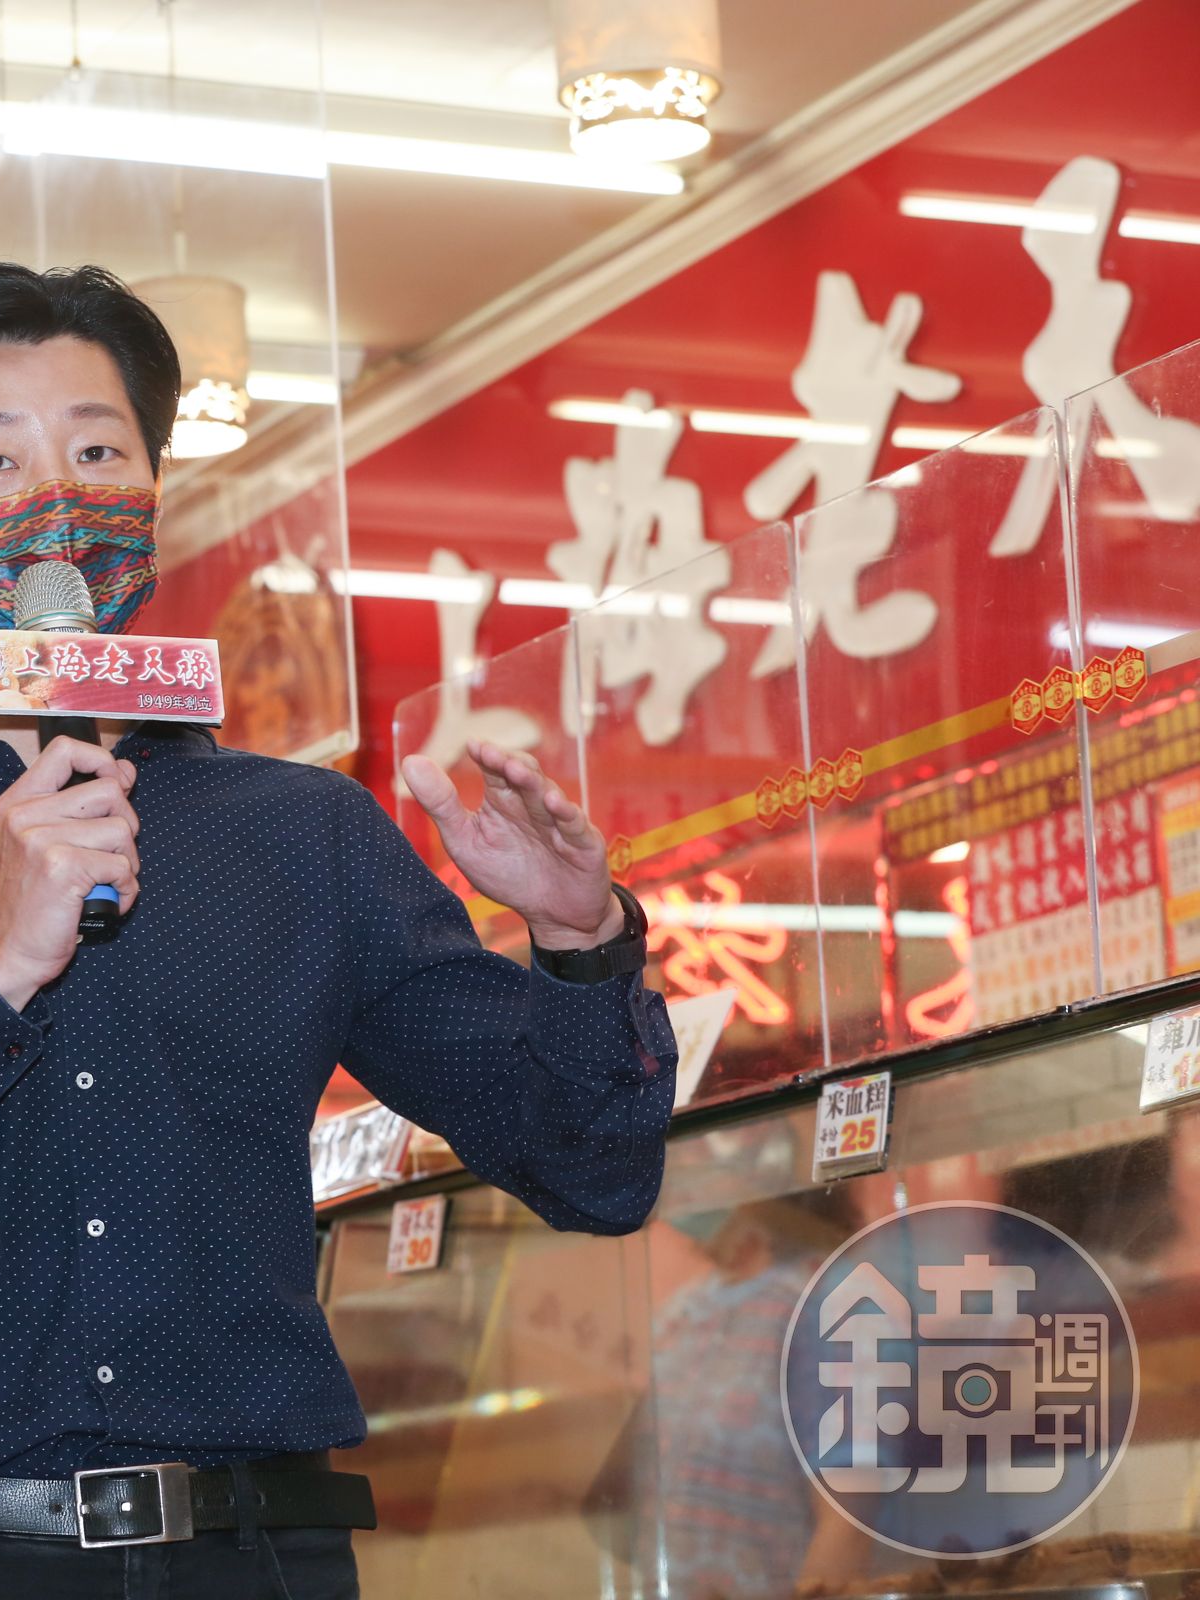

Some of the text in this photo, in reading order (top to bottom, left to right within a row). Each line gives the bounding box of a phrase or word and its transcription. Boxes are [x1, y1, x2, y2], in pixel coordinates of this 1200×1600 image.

[14, 642, 214, 690] 上海老天祿
[137, 694, 212, 712] 1949年創立
[825, 1079, 887, 1119] 米血糕
[840, 1117, 877, 1156] 25
[407, 1236, 433, 1265] 30
